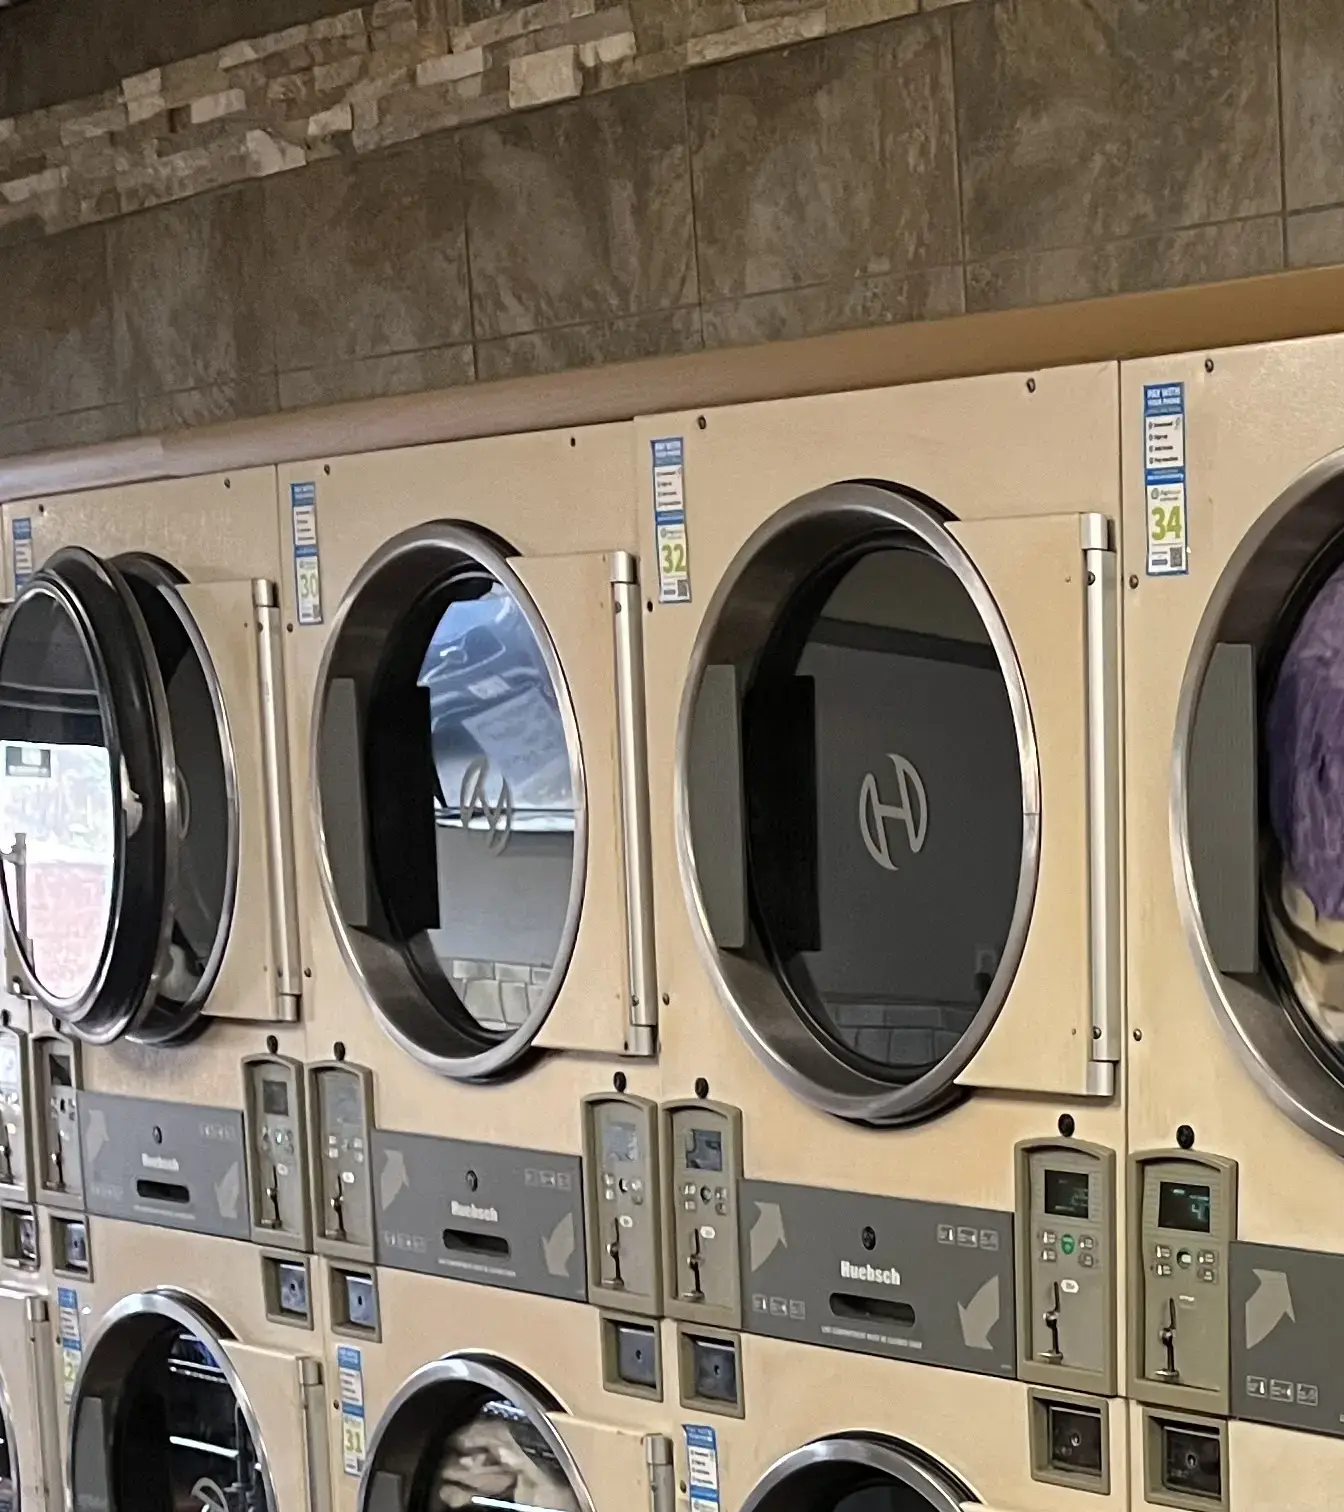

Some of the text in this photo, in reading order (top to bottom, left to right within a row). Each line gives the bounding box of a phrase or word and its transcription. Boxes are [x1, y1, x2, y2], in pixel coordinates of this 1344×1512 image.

[1151, 505, 1182, 541] 34
[662, 543, 687, 574] 32
[840, 1260, 901, 1286] Huebsch
[345, 1428, 363, 1453] 31
